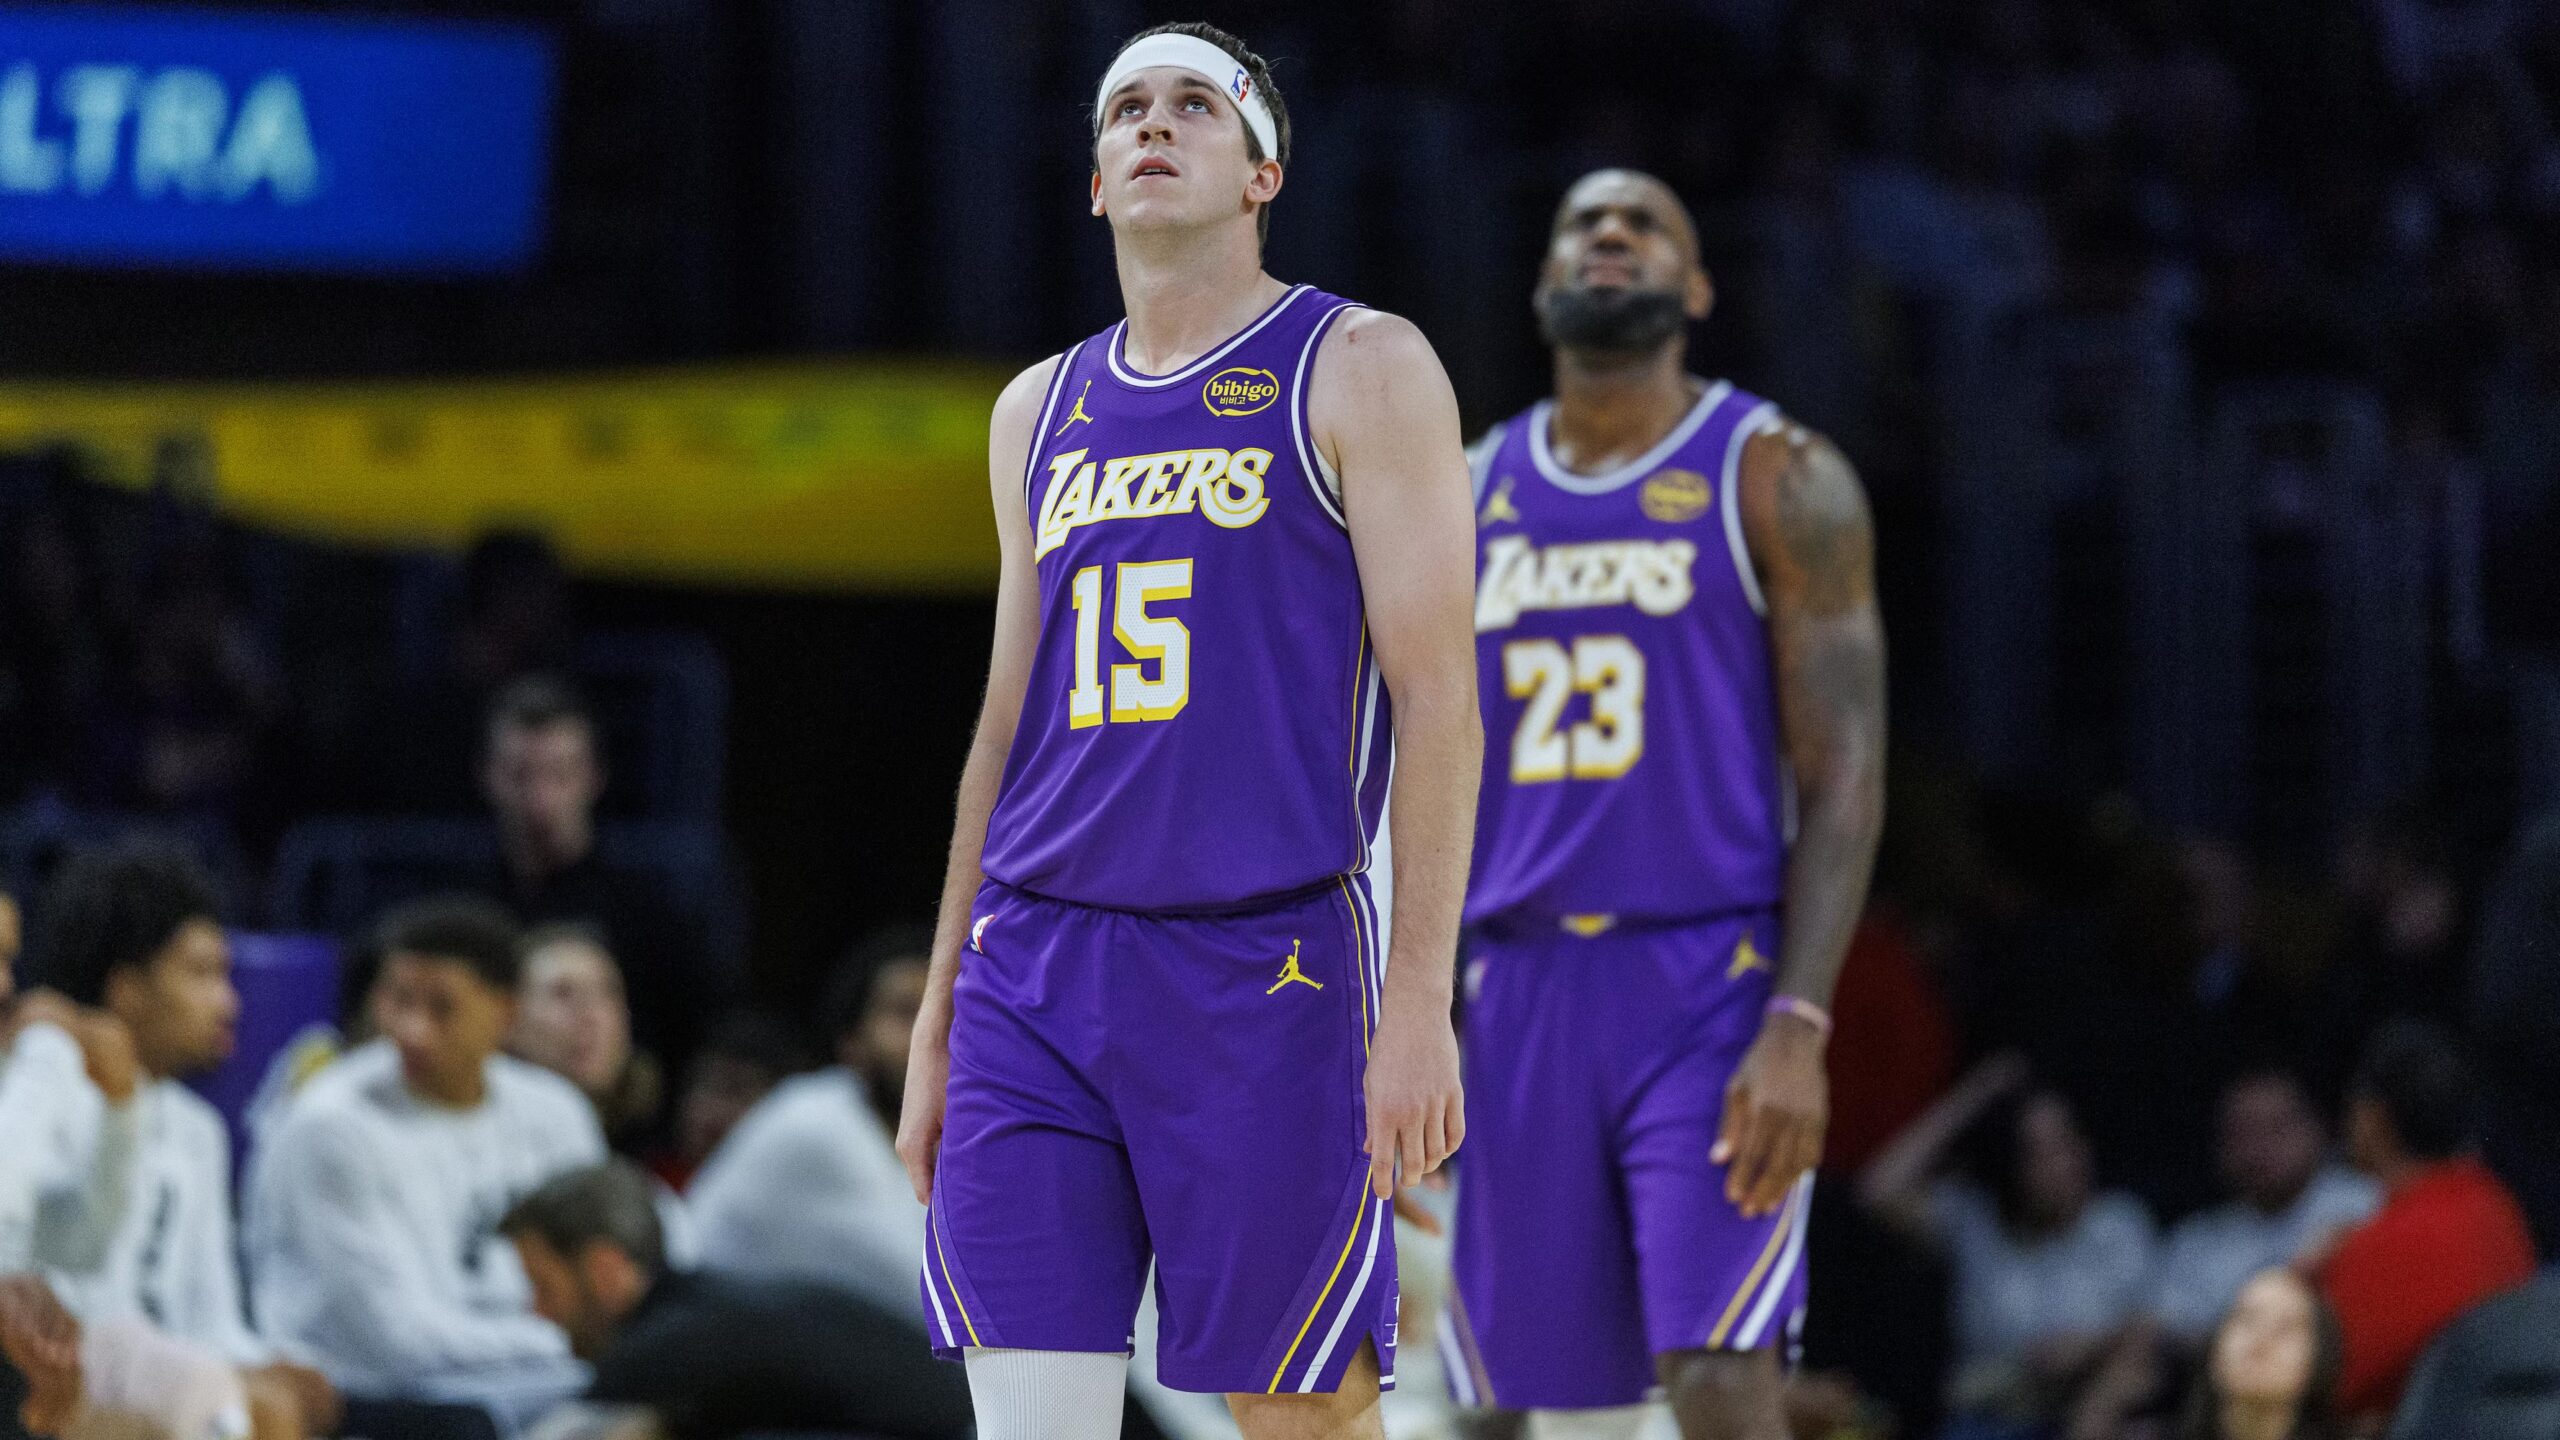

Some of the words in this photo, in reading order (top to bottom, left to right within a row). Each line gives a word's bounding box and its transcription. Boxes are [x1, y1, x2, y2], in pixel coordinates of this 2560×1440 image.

[1210, 379, 1275, 401] bibigo
[1219, 396, 1246, 405] 비비고
[1035, 447, 1274, 565] LAKERS
[1475, 534, 1697, 634] LAKERS
[1069, 557, 1194, 730] 15
[1503, 635, 1645, 784] 23
